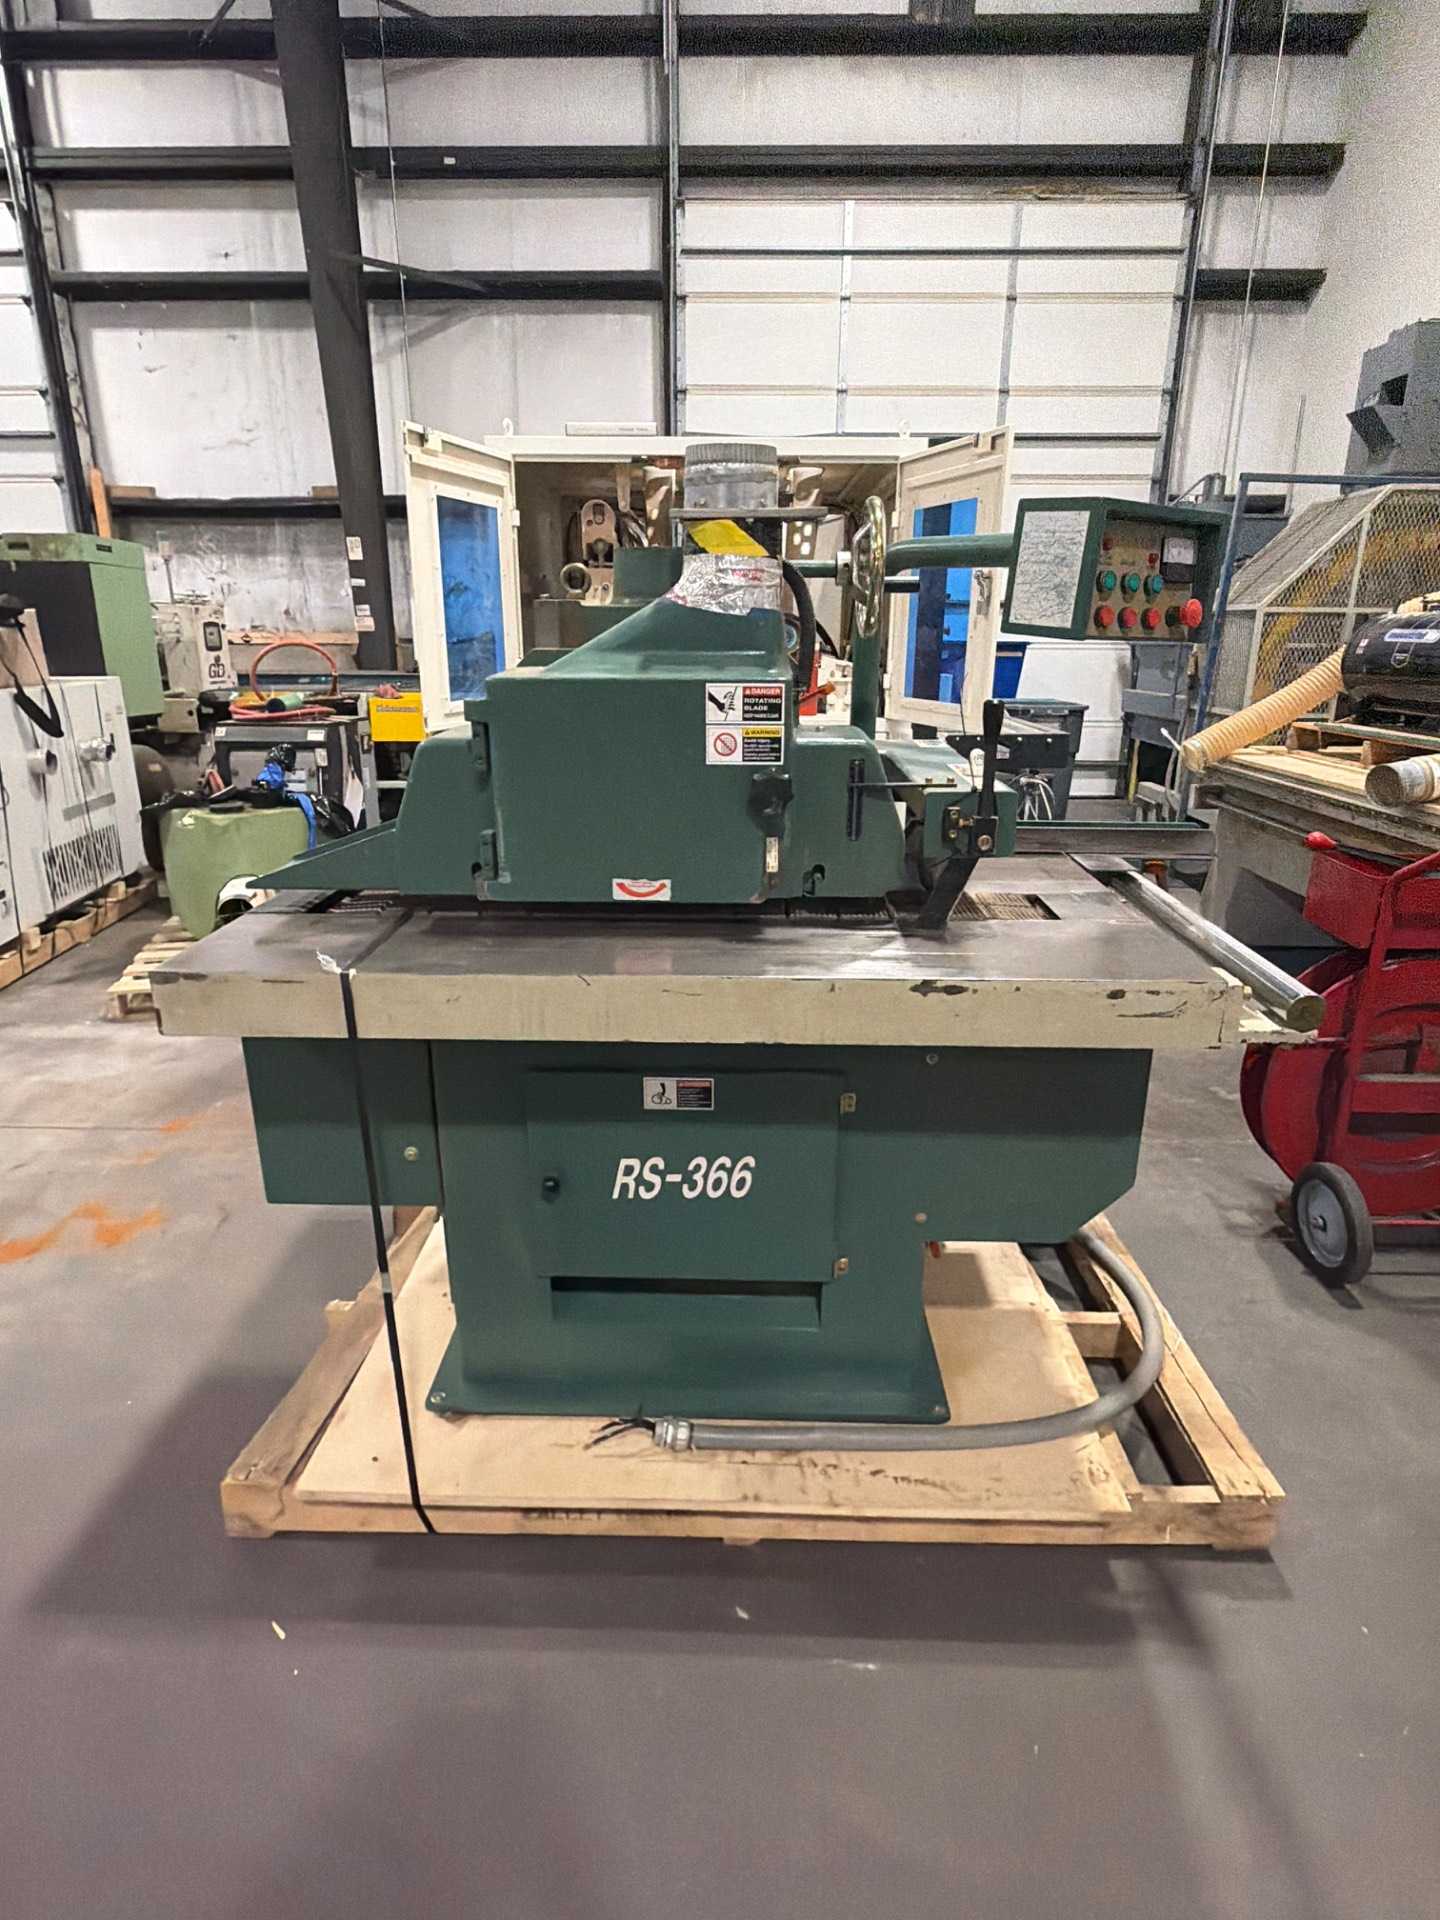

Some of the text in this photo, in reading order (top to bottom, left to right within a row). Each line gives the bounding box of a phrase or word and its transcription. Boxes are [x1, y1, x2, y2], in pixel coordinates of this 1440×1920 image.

[751, 687, 781, 696] DANGER
[750, 728, 780, 736] WARNING
[612, 1156, 756, 1200] RS-366
